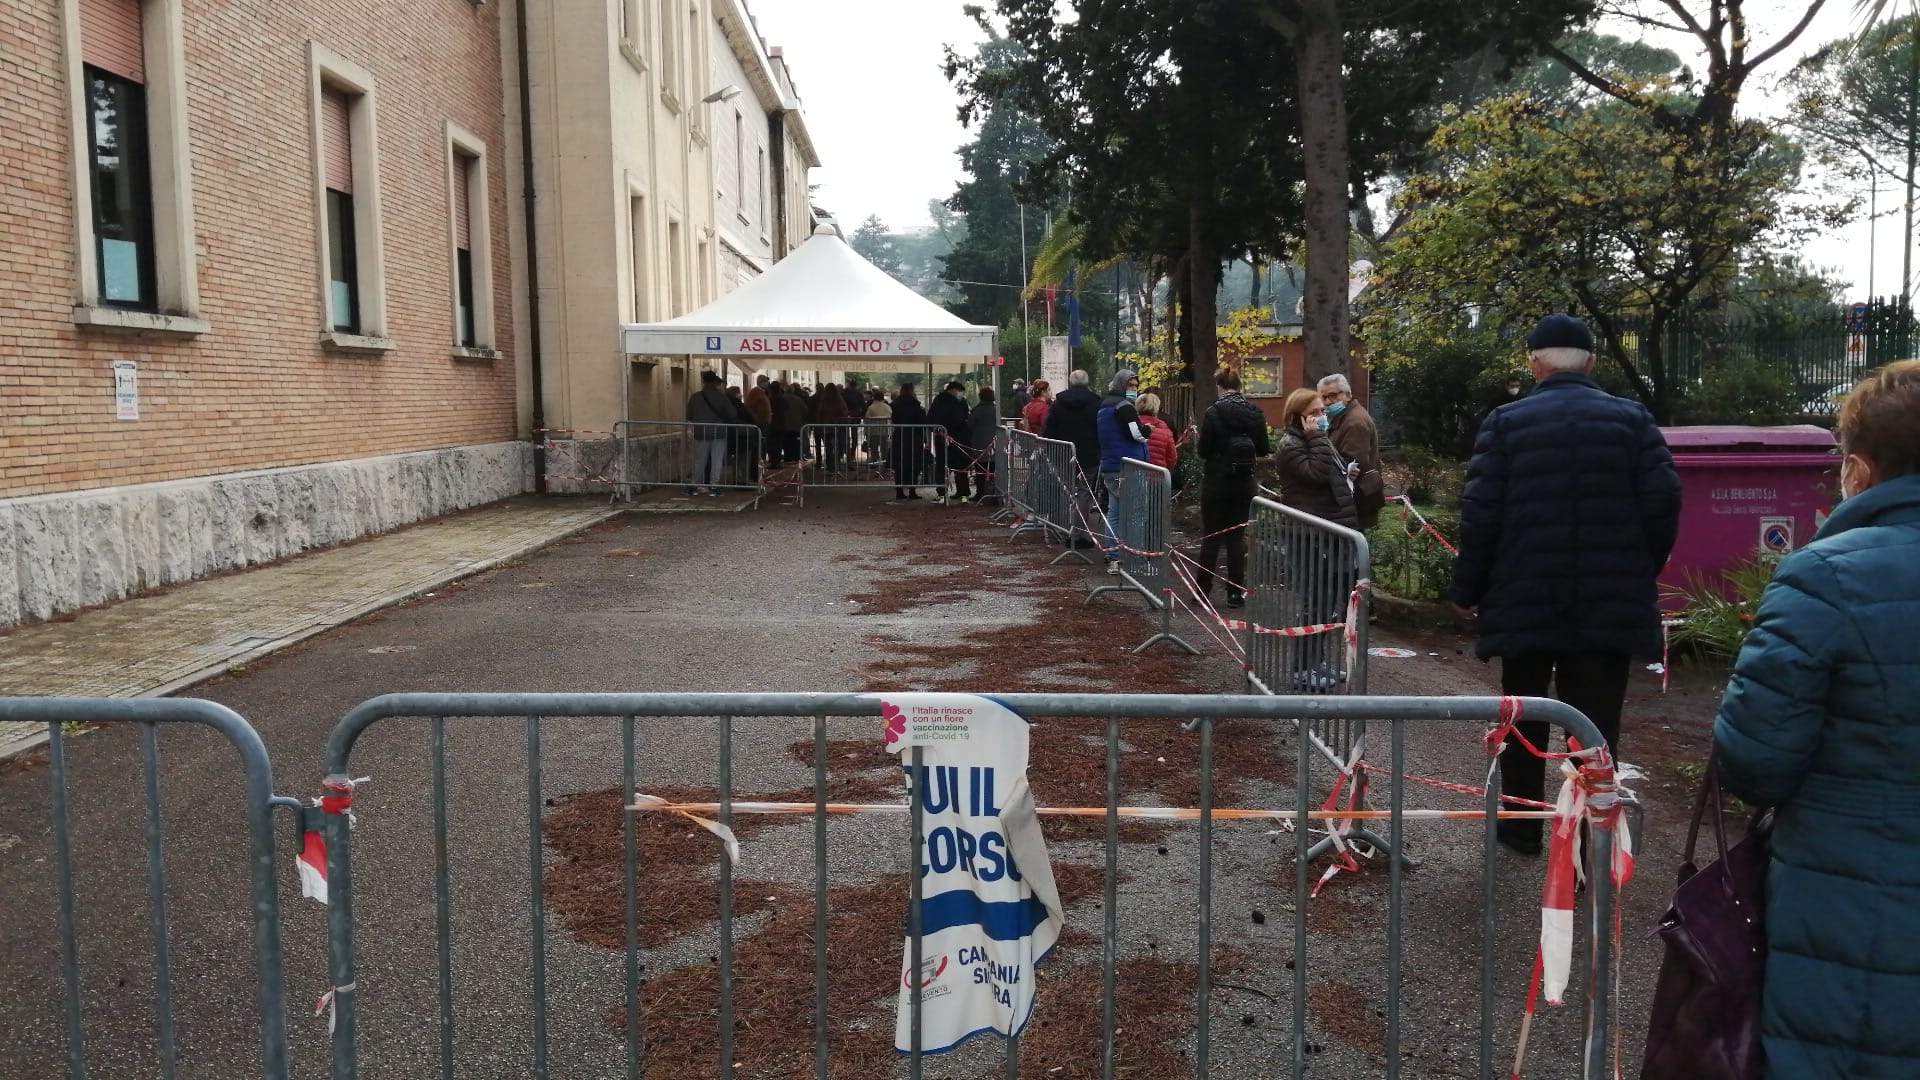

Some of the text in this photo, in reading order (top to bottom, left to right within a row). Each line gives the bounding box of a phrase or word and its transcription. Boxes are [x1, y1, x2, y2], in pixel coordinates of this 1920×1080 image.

[739, 338, 882, 352] ASL BENEVENTO
[912, 706, 973, 714] l'Italia rinasce
[912, 723, 969, 731] vaccinazione
[912, 732, 970, 740] anti-Covid 19
[970, 766, 1002, 817] IL
